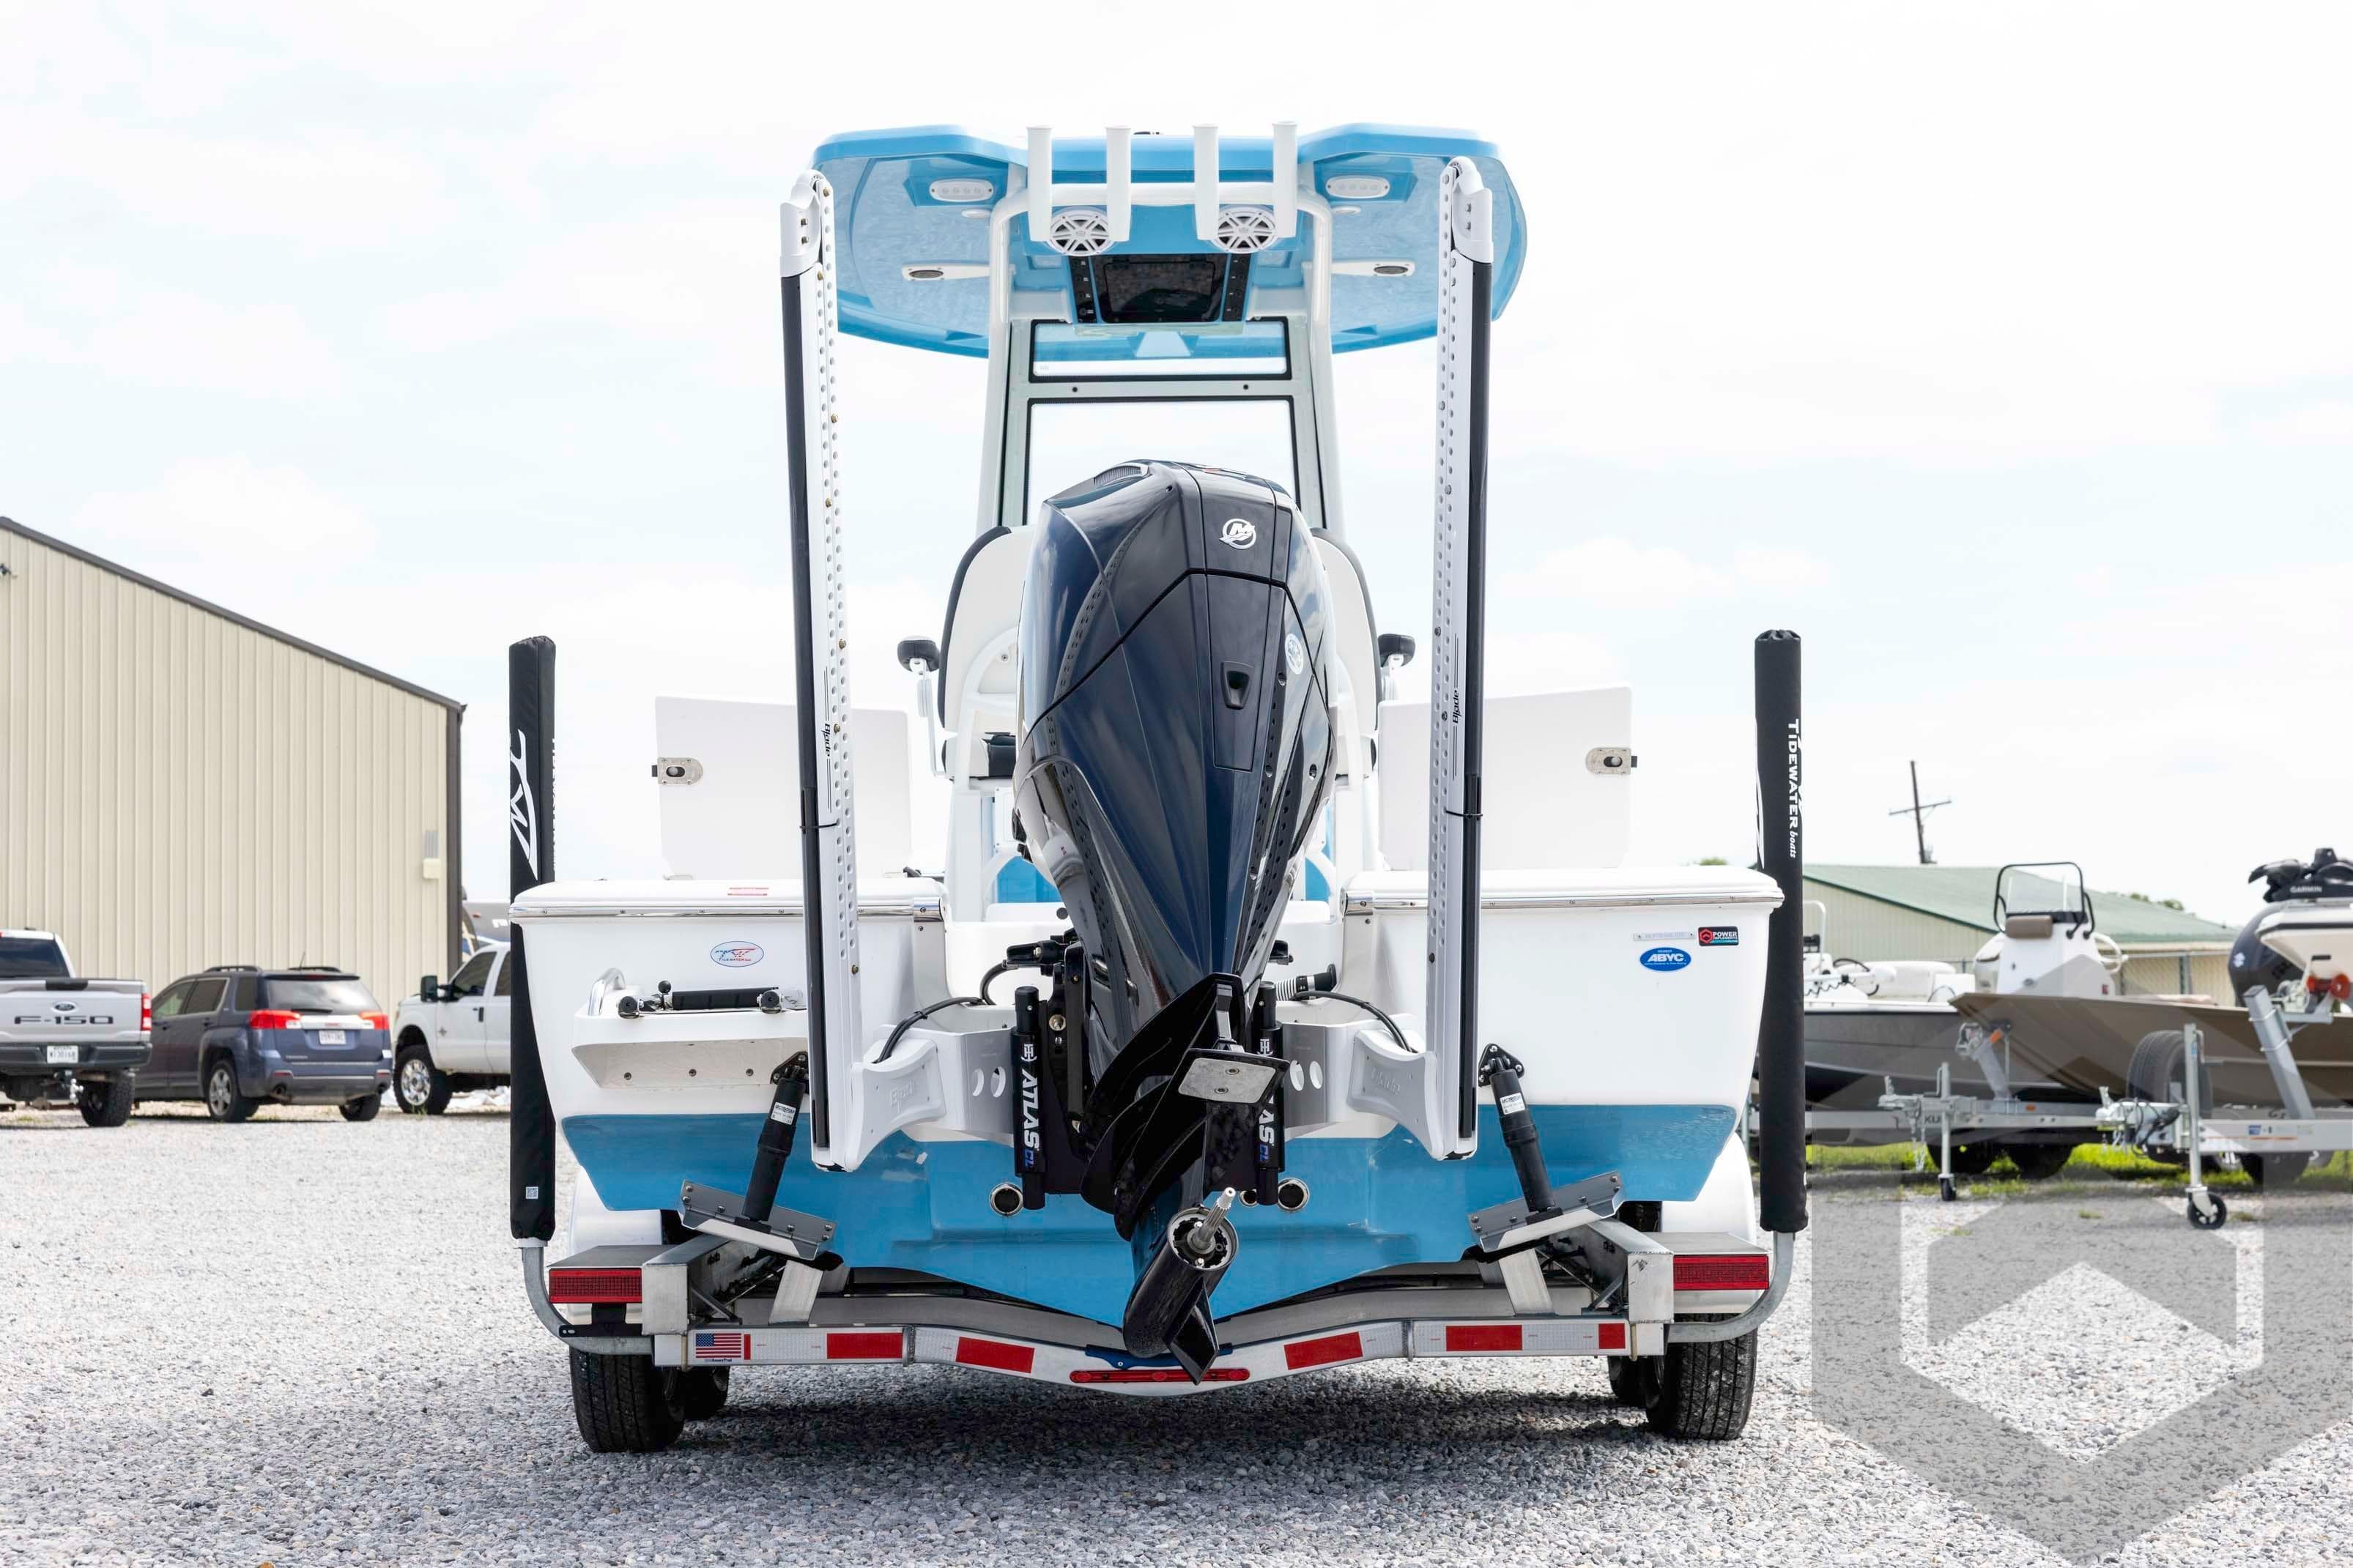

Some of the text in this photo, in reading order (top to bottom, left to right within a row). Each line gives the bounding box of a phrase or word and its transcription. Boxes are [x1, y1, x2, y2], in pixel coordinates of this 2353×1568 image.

[1788, 718, 1799, 858] TIDEWATER boats
[1647, 953, 1685, 962] ABYC
[14, 1015, 114, 1025] F-150
[1021, 1068, 1040, 1150] ATLAS
